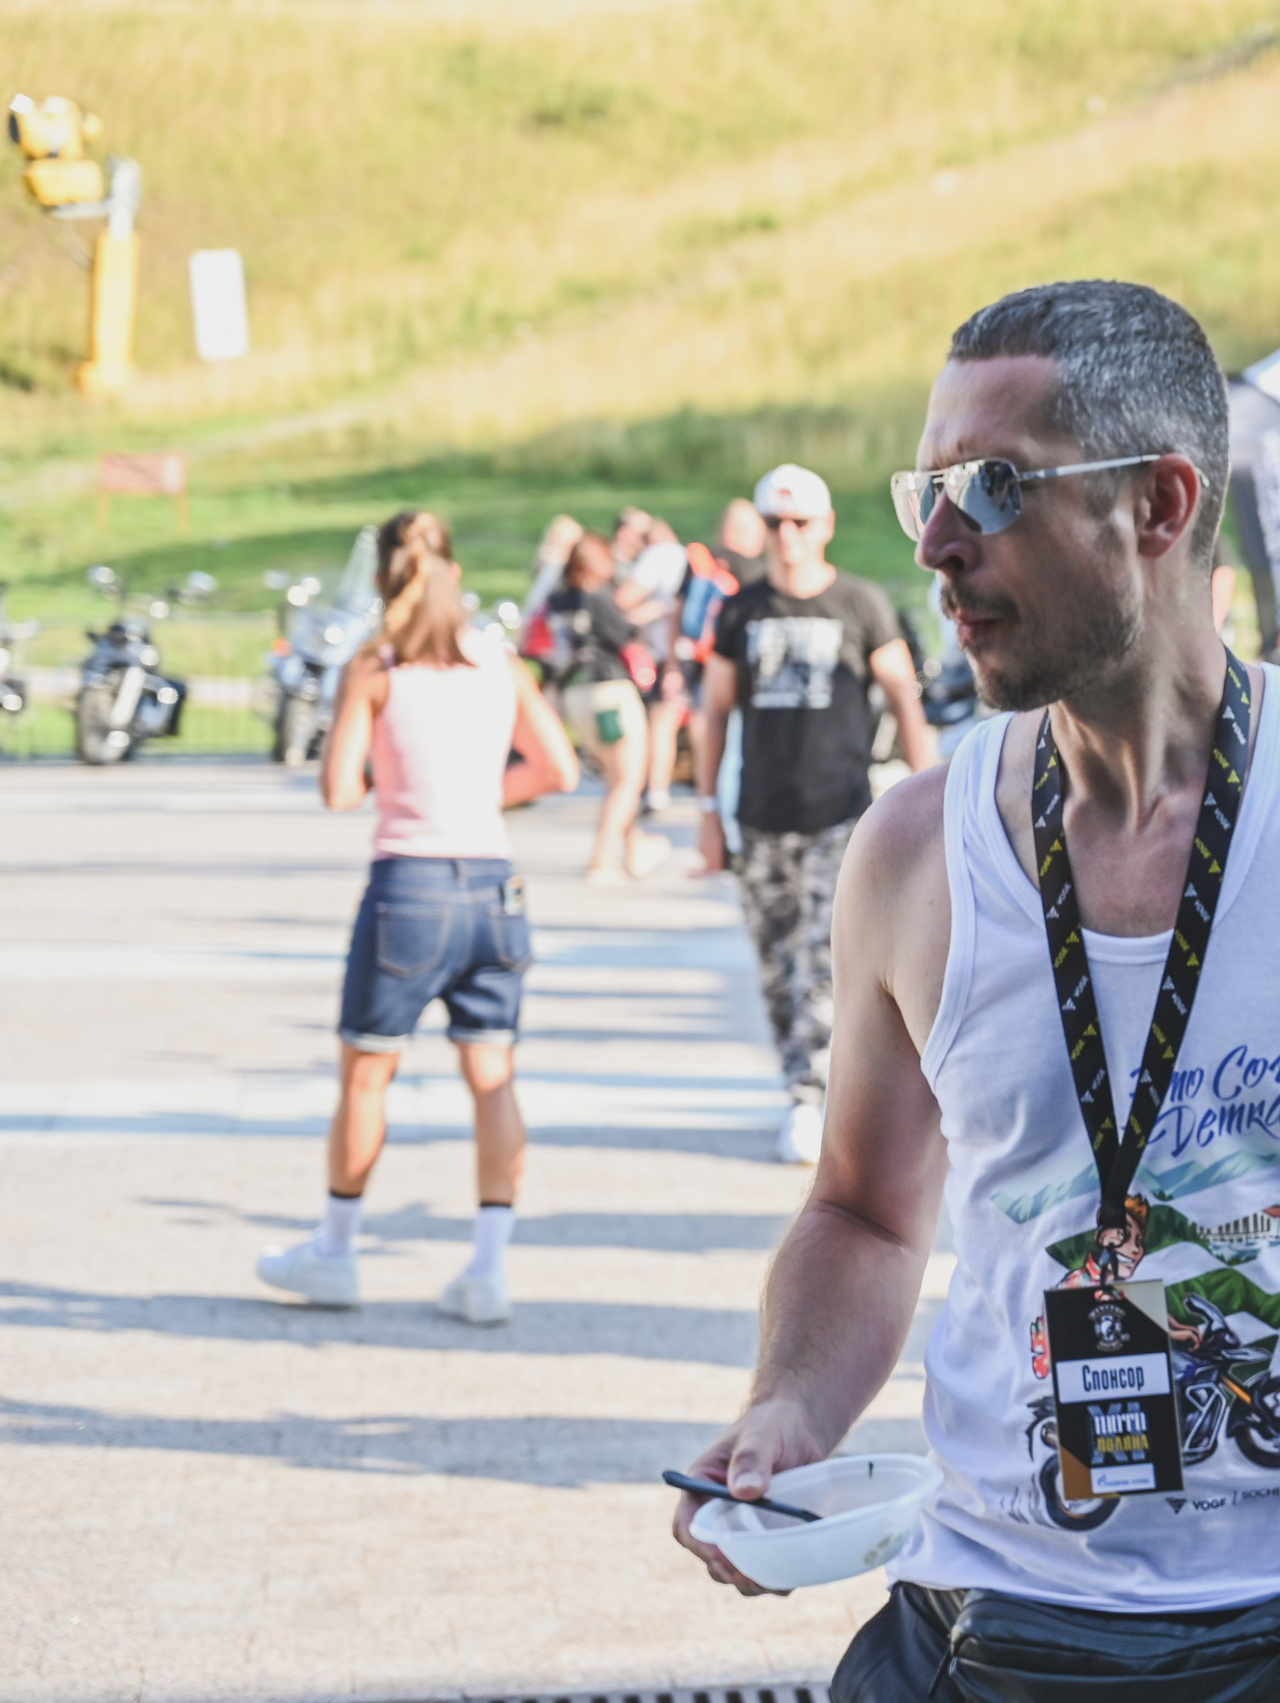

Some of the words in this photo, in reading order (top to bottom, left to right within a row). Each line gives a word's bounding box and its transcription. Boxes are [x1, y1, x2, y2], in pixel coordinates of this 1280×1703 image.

[1130, 1067, 1204, 1102] то
[1082, 1365, 1145, 1392] Спонсор
[1242, 1487, 1280, 1499] SOCHI
